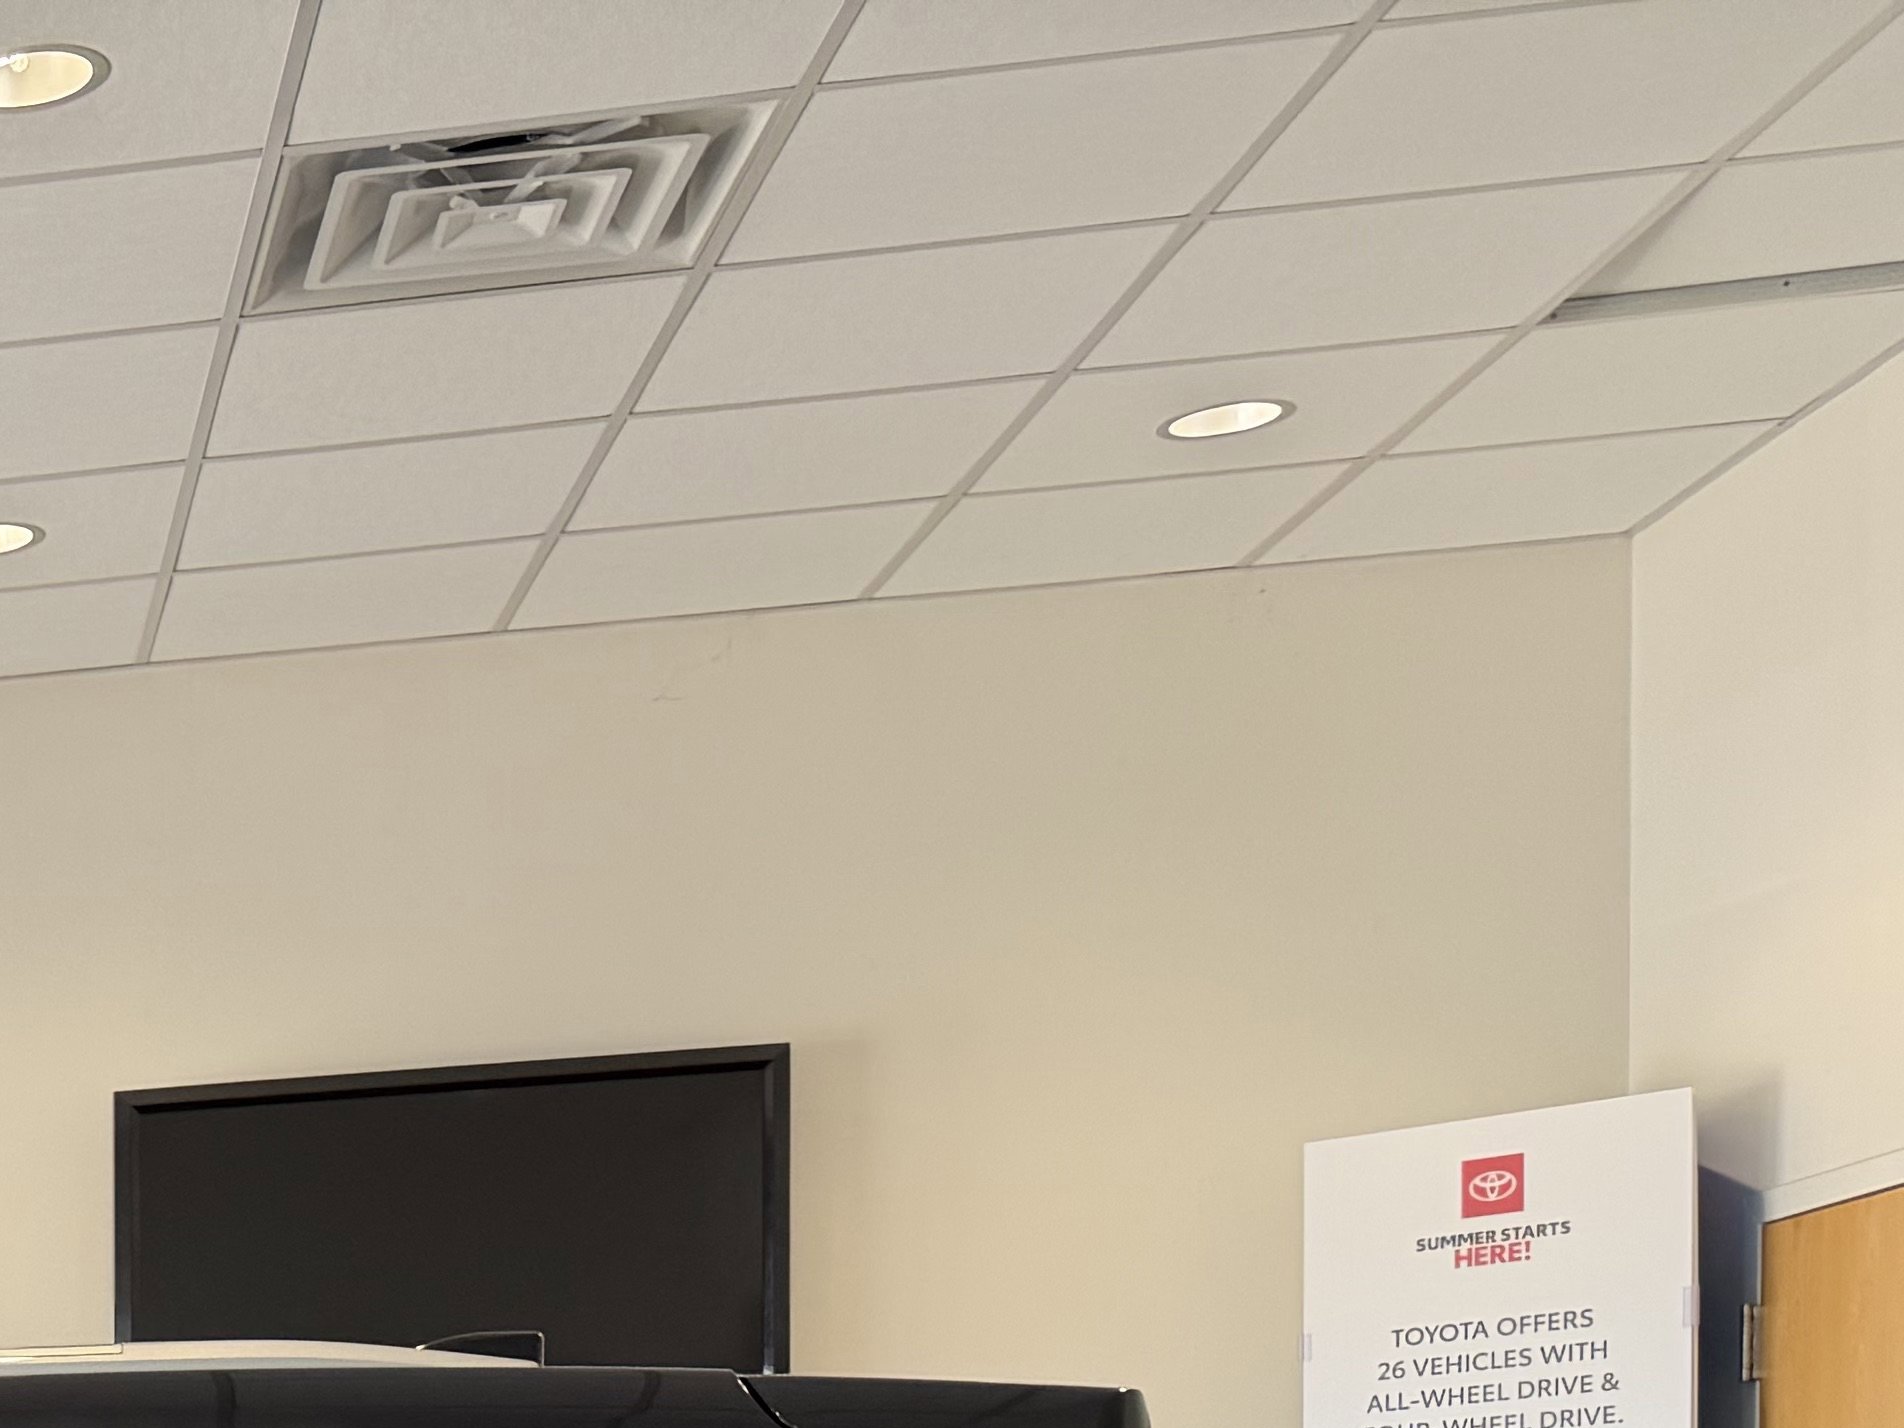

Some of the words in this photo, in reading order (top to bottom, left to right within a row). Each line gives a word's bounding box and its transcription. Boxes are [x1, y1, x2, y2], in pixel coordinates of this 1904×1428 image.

[1416, 1230, 1496, 1252] SUMMER
[1501, 1221, 1571, 1241] STARTS
[1454, 1240, 1532, 1269] HERE!
[1392, 1320, 1489, 1348] TOYOTA
[1497, 1308, 1594, 1336] OFFERS
[1378, 1361, 1406, 1381] 26
[1413, 1348, 1533, 1377] VEHICLES
[1540, 1340, 1608, 1365] WITH
[1367, 1382, 1510, 1414] ALL-WHEEL
[1518, 1374, 1594, 1400] DRIVE
[1601, 1372, 1619, 1392] &
